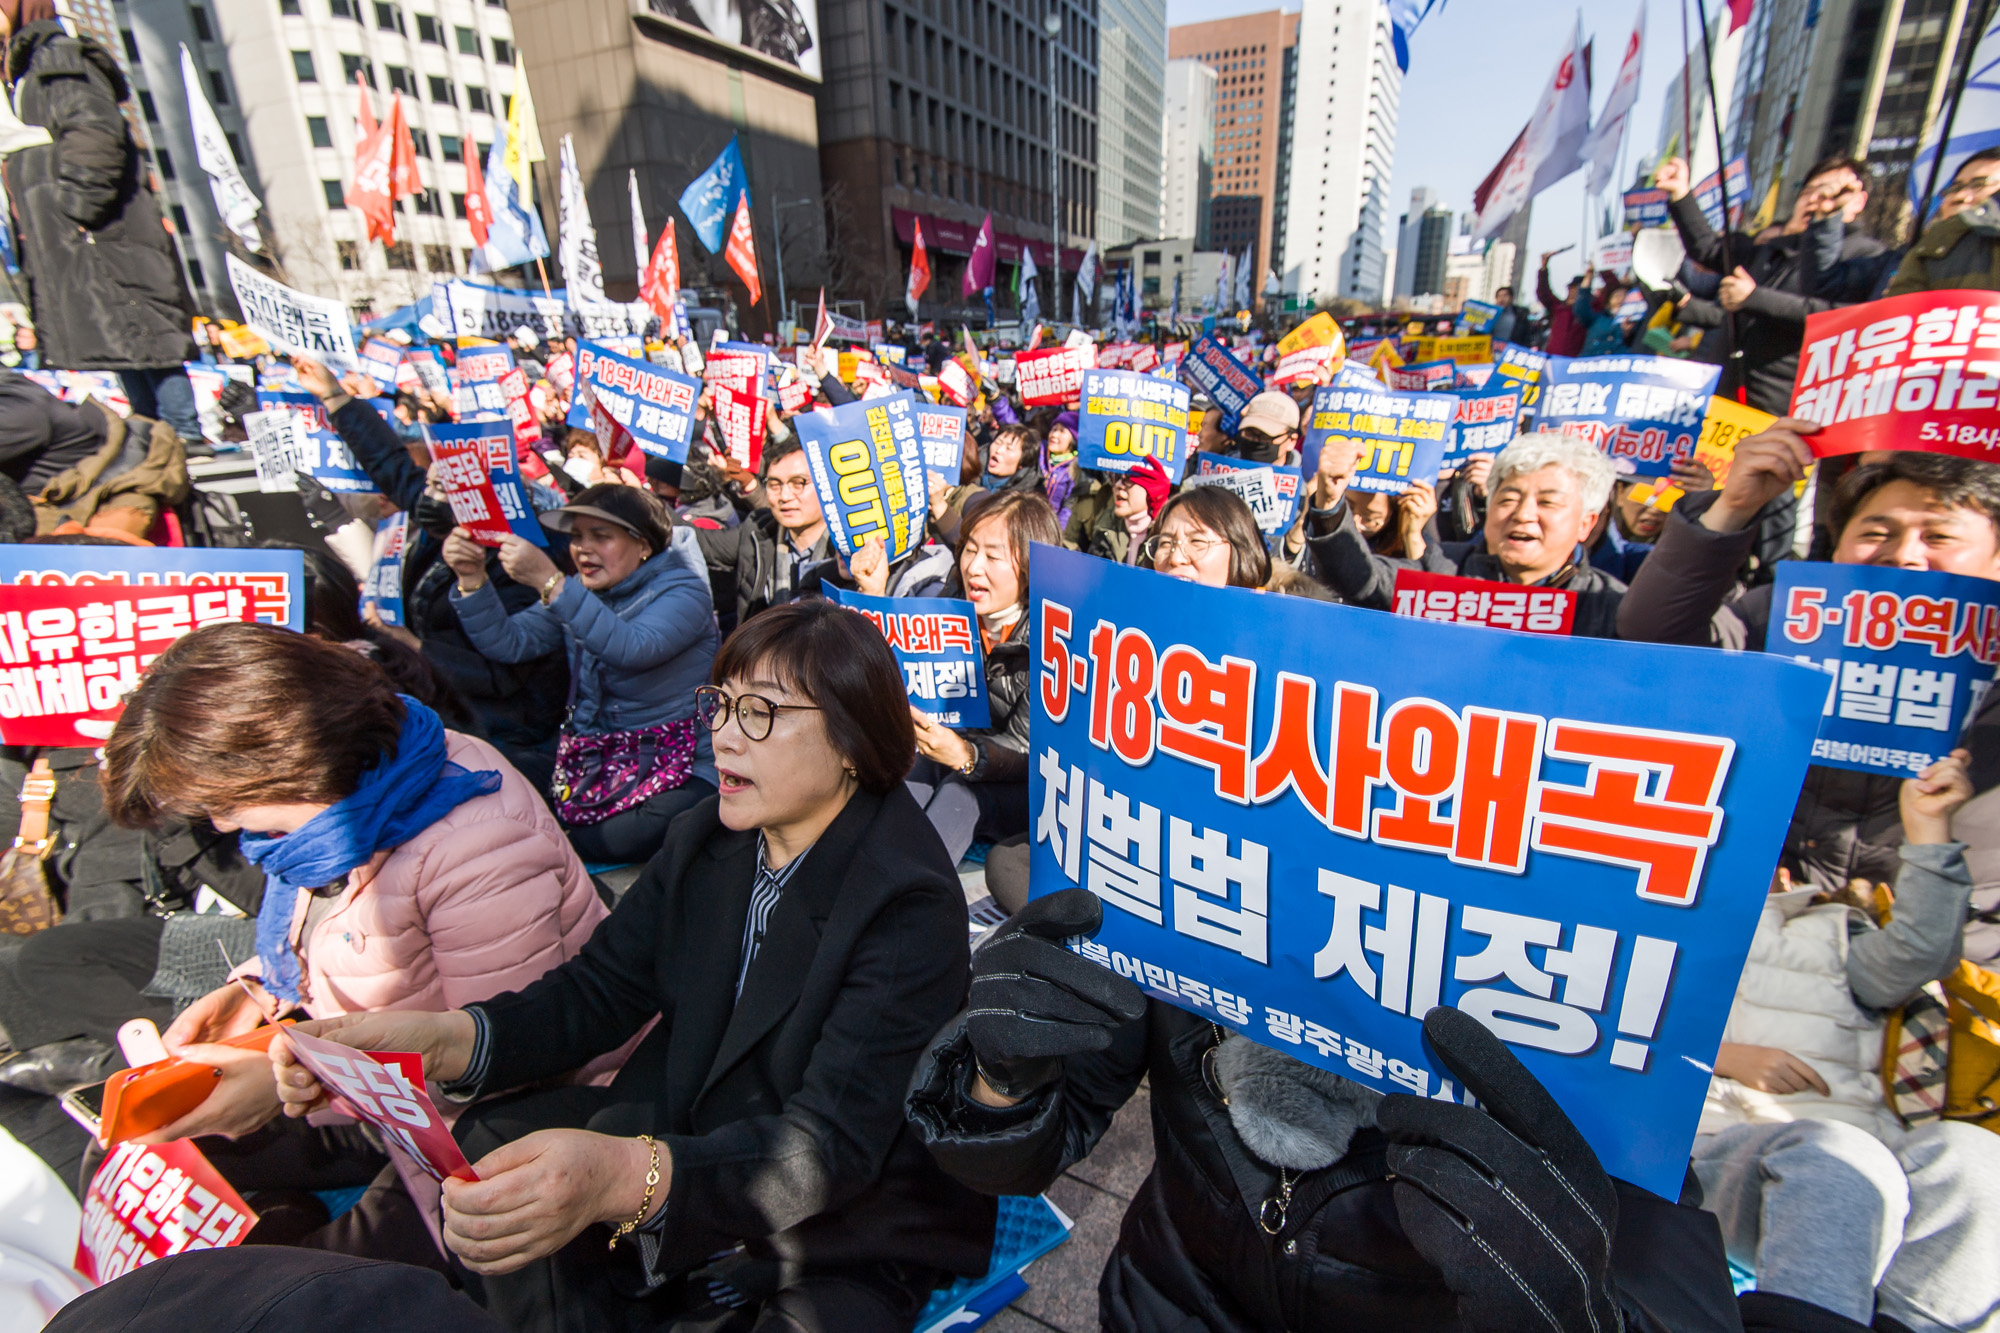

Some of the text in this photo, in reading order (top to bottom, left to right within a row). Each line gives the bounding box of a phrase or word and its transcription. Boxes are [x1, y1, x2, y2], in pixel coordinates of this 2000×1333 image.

[579, 349, 695, 414] 5·18역사왜곡
[1541, 382, 1613, 418] 제정!
[636, 404, 688, 443] 제정!
[1104, 421, 1177, 463] OUT!
[865, 405, 897, 463] 김진태,
[881, 460, 908, 515] 이종명,
[829, 439, 890, 548] OUT!
[1395, 590, 1569, 632] 자유한국당
[903, 660, 978, 700] 제정!
[1041, 598, 1736, 908] 5·18역사왜곡
[1811, 739, 1933, 773] 더불어민주당
[1036, 745, 1678, 1073] 처벌법 제정!
